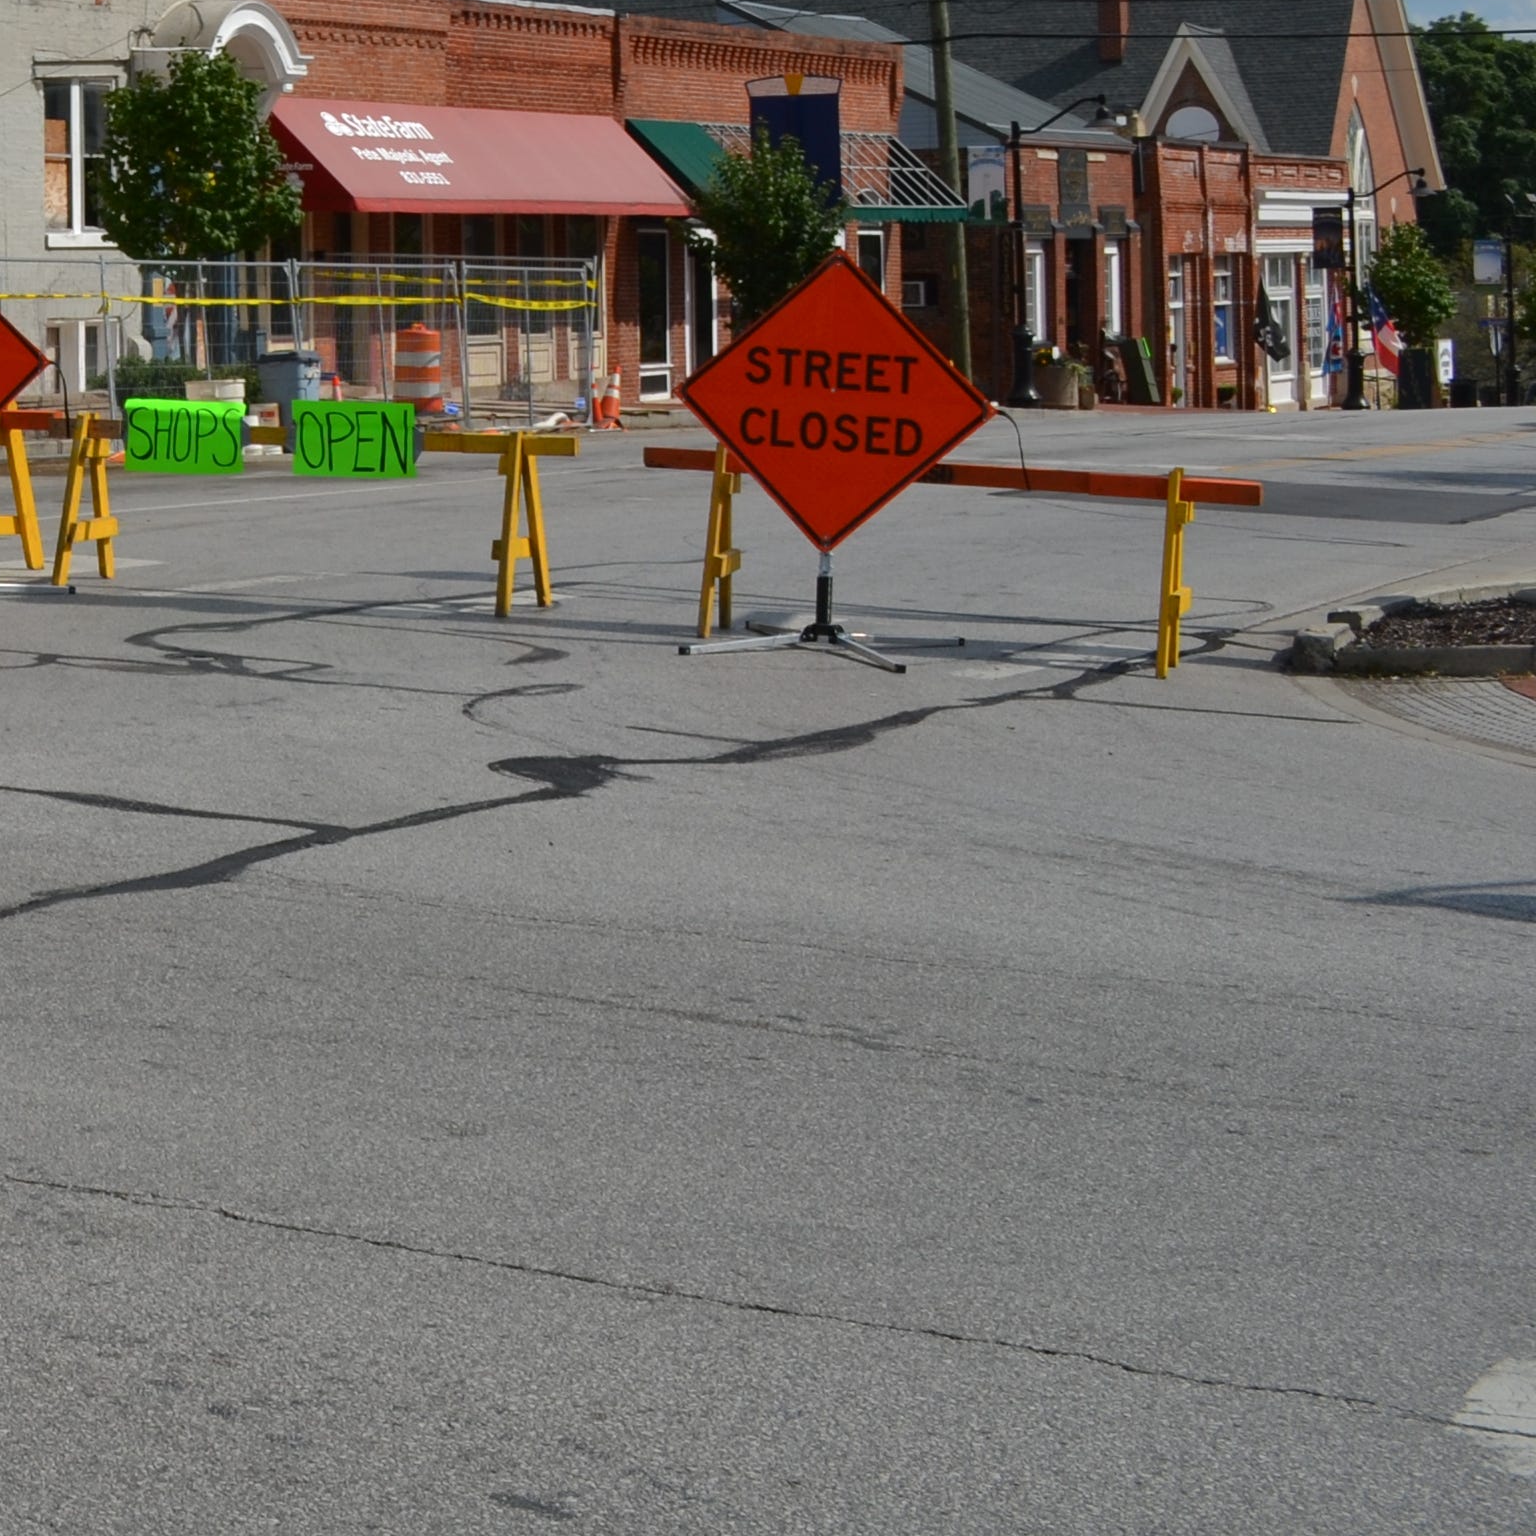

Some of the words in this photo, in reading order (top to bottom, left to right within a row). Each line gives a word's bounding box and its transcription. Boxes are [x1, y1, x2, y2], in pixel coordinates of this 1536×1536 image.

[351, 146, 382, 161] Pete
[418, 149, 454, 166] Agent
[745, 346, 918, 394] STREET
[129, 407, 241, 467] SHOPS
[299, 409, 408, 474] OPEN
[740, 407, 923, 457] CLOSED
